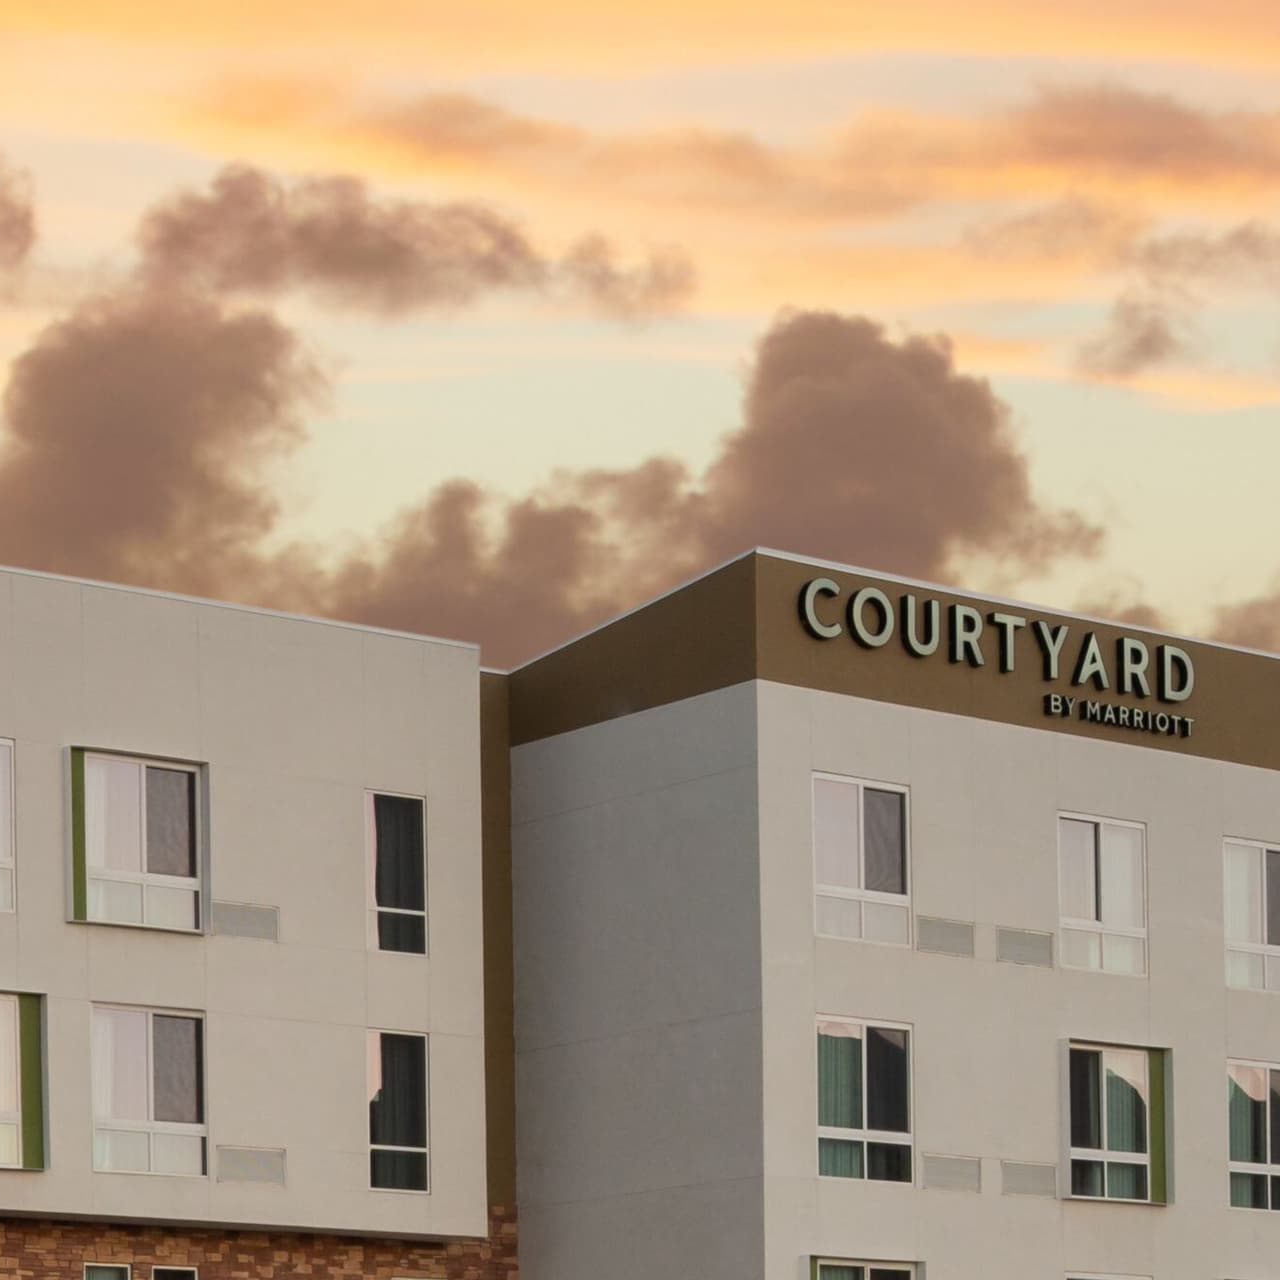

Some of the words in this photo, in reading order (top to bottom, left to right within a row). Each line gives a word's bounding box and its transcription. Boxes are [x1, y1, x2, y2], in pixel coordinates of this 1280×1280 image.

[800, 577, 1195, 702] COURTYARD
[1046, 693, 1076, 716] BY
[1083, 701, 1195, 738] MARRIOTT
